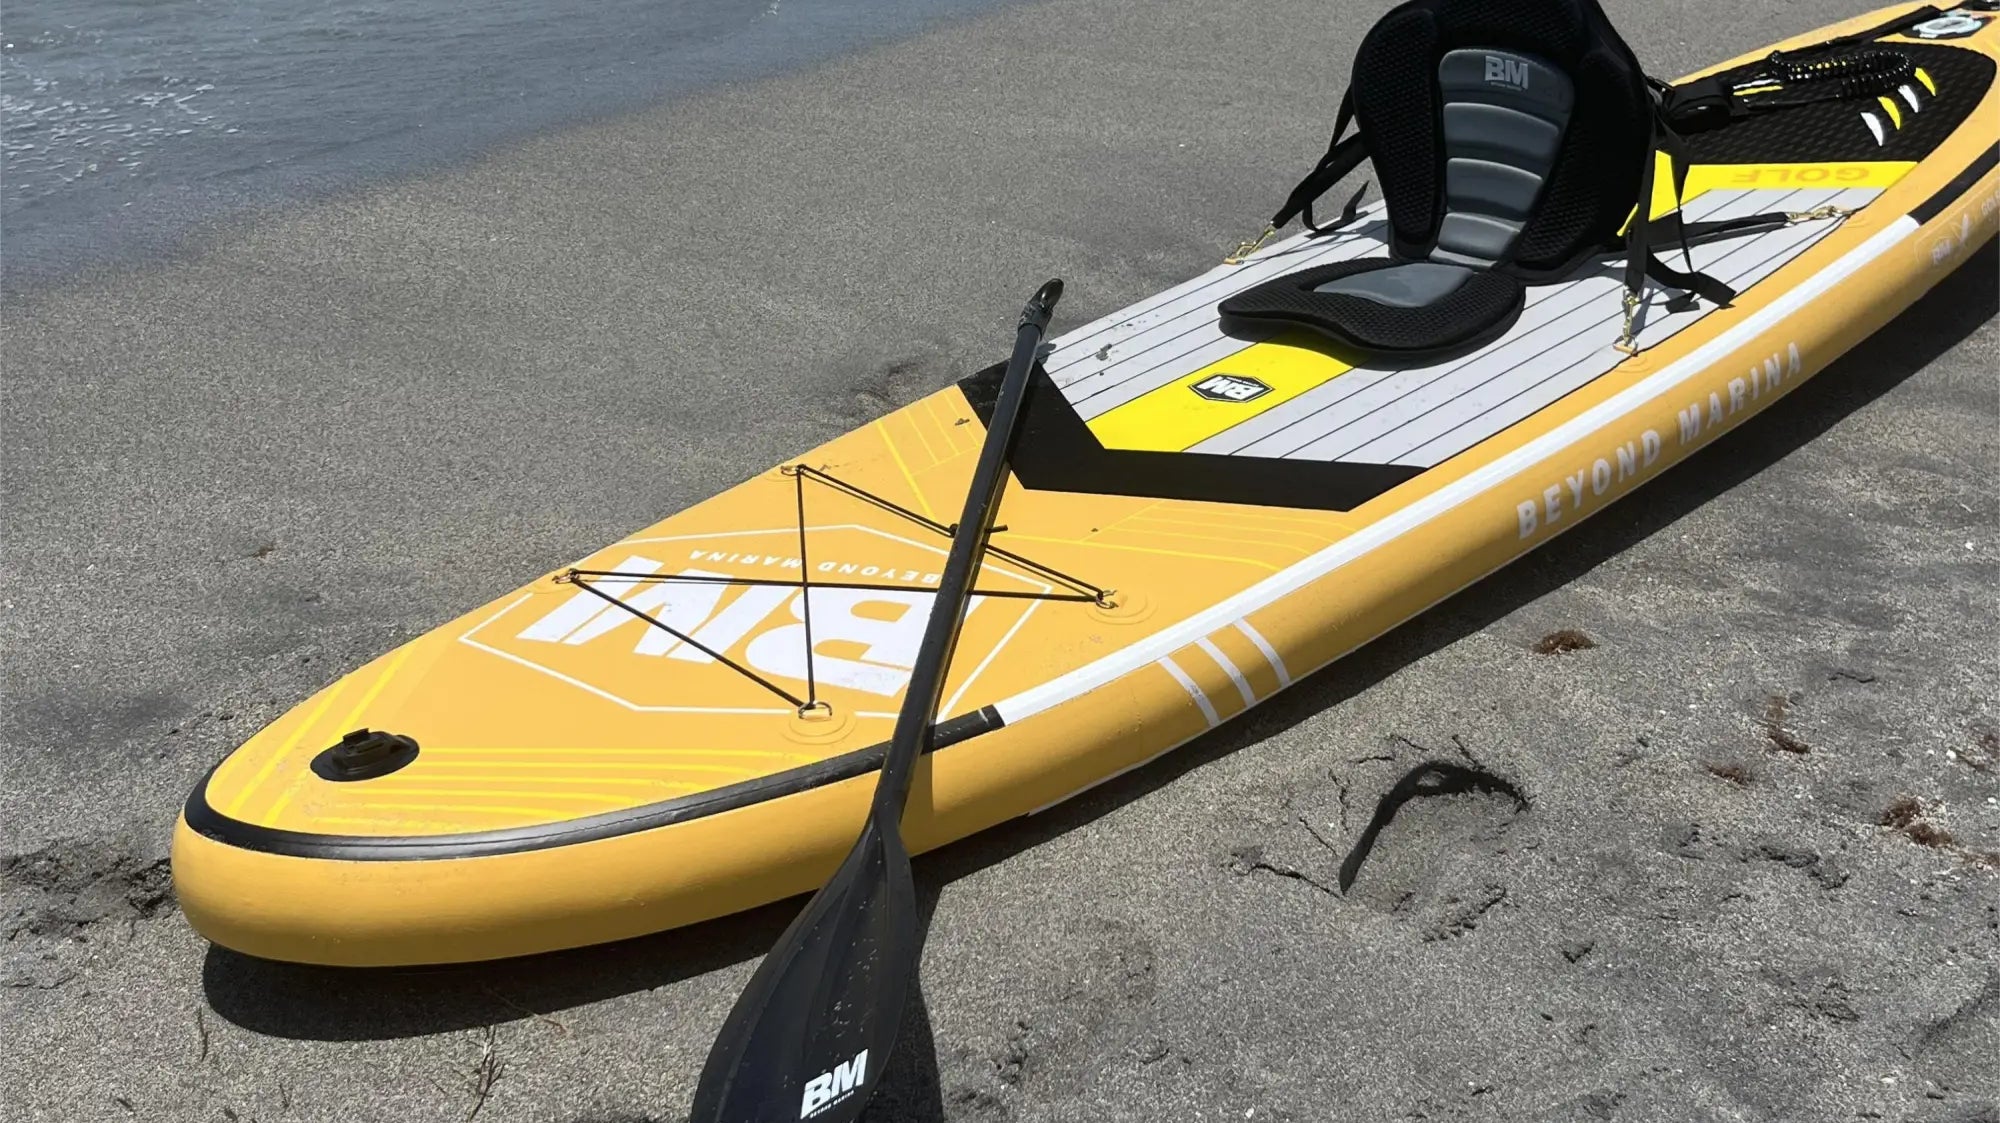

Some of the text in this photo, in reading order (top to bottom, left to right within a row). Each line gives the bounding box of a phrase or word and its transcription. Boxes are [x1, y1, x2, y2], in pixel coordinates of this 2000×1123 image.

[1485, 56, 1529, 90] BM
[1731, 167, 1870, 183] GOLF
[1196, 376, 1265, 400] BM
[1516, 342, 1800, 540] BEYOND MARINA
[689, 550, 942, 584] BEYOND MARINA
[515, 555, 984, 698] BM
[800, 1048, 869, 1120] BM
